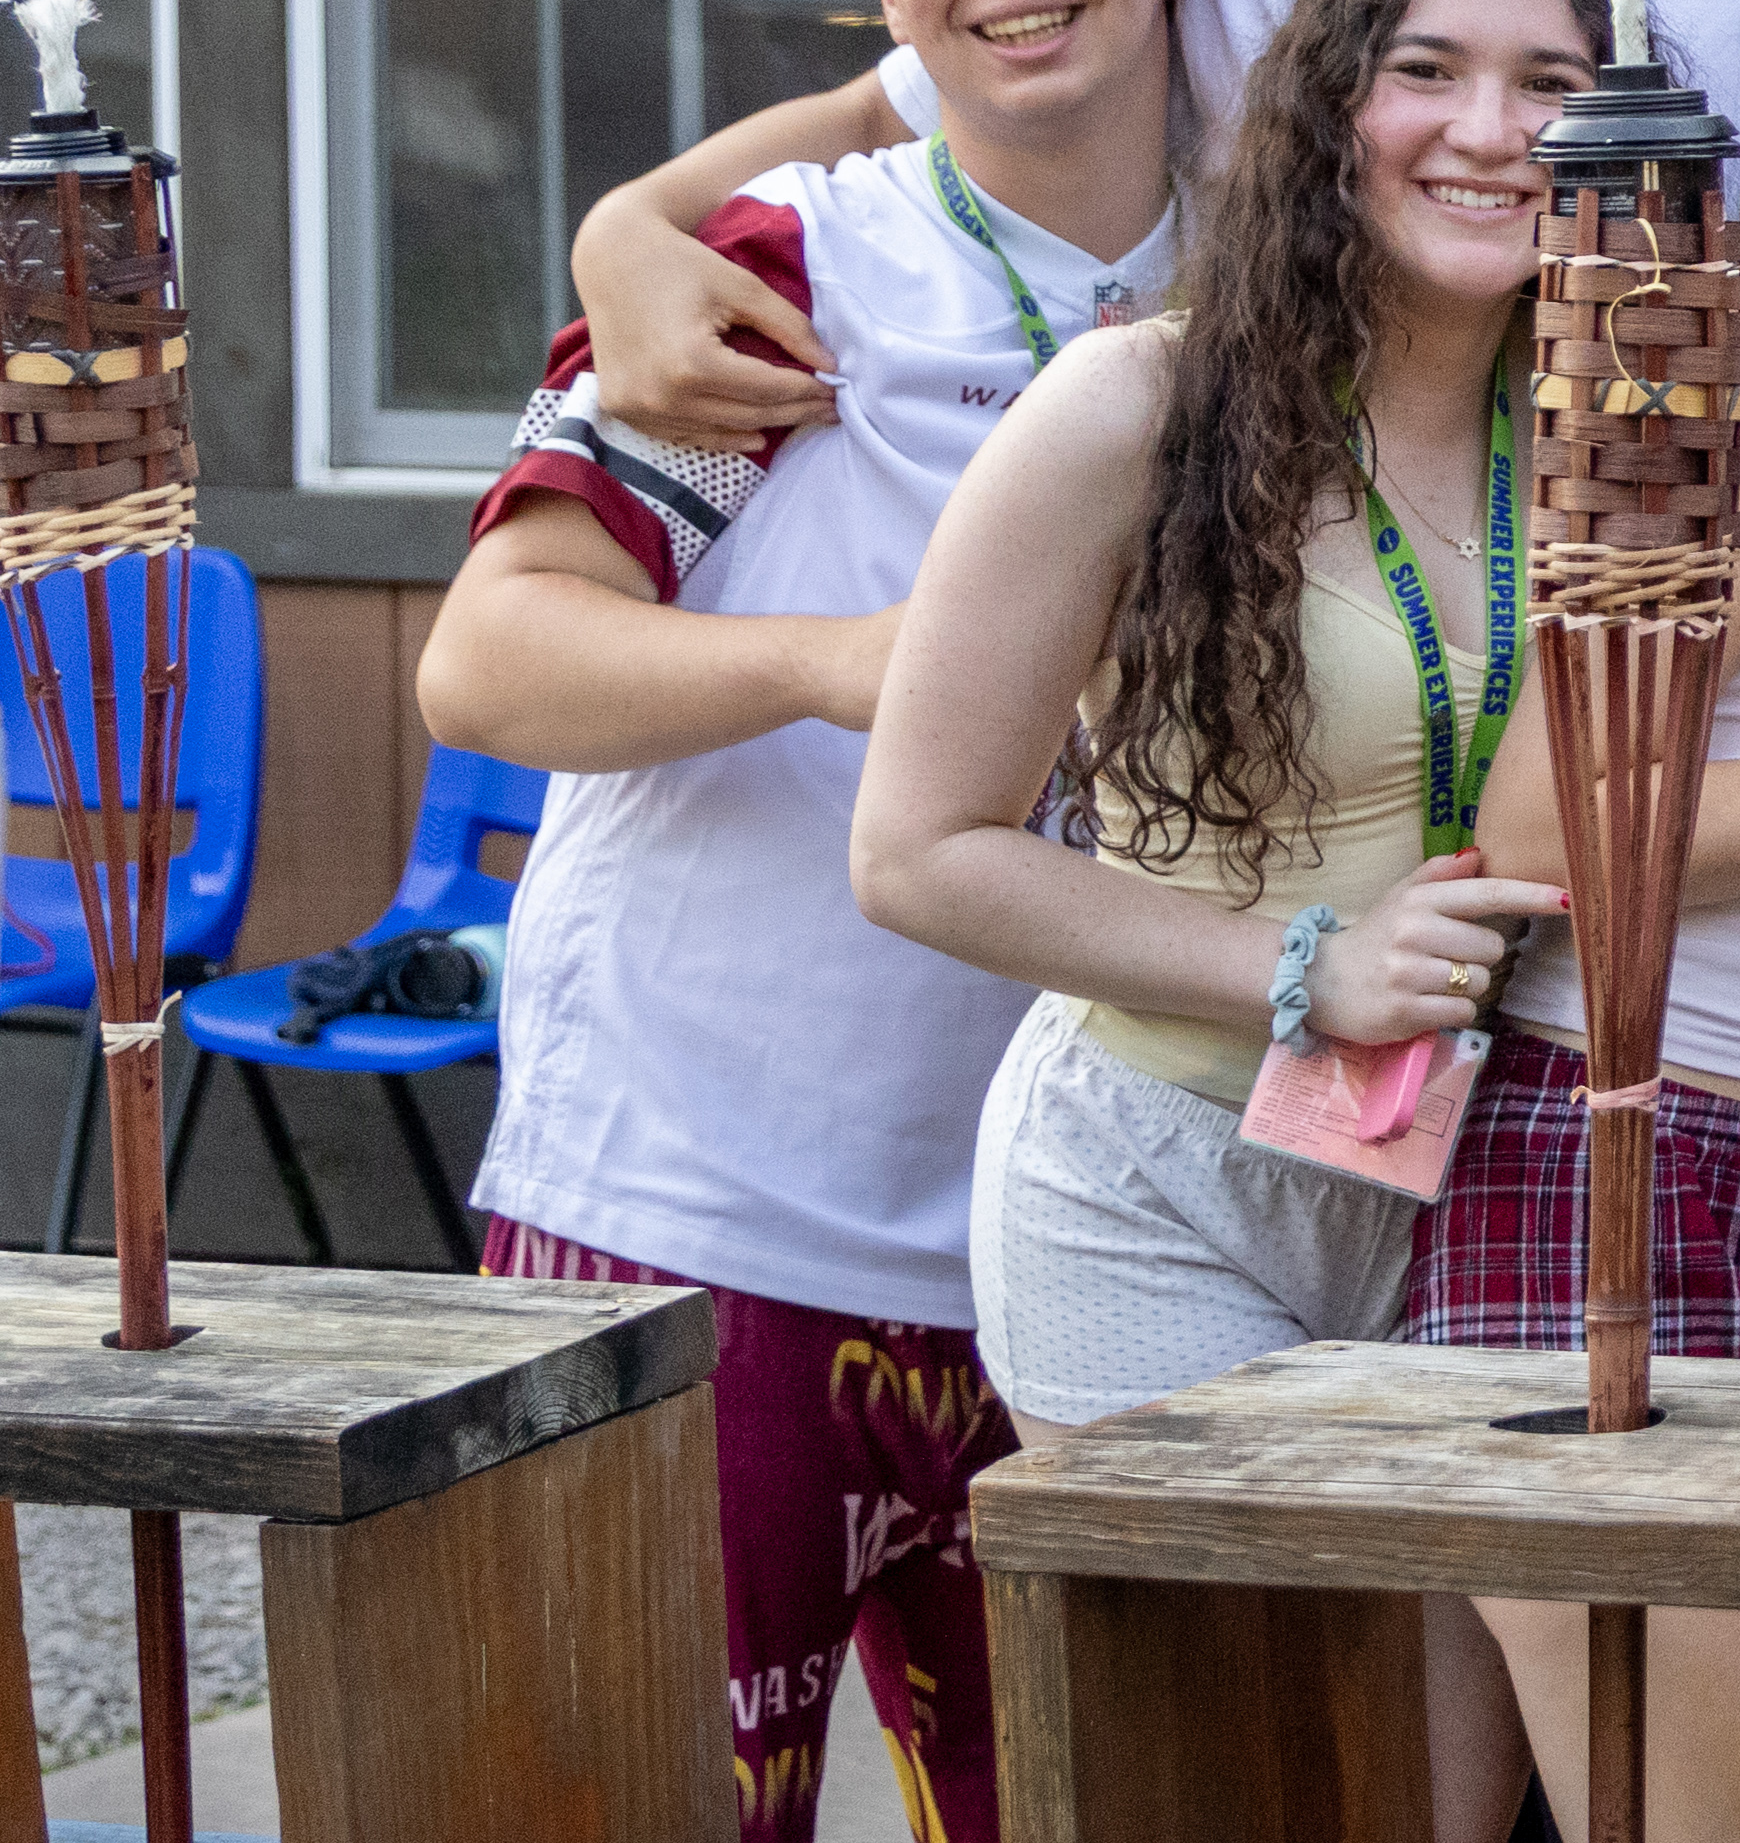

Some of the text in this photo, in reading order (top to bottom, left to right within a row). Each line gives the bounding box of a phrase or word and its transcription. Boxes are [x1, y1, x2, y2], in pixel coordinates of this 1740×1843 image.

[1389, 562, 1455, 827] SUMMER EXPERIENCES
[1482, 451, 1517, 718] SUMMER EXPERIENCES
